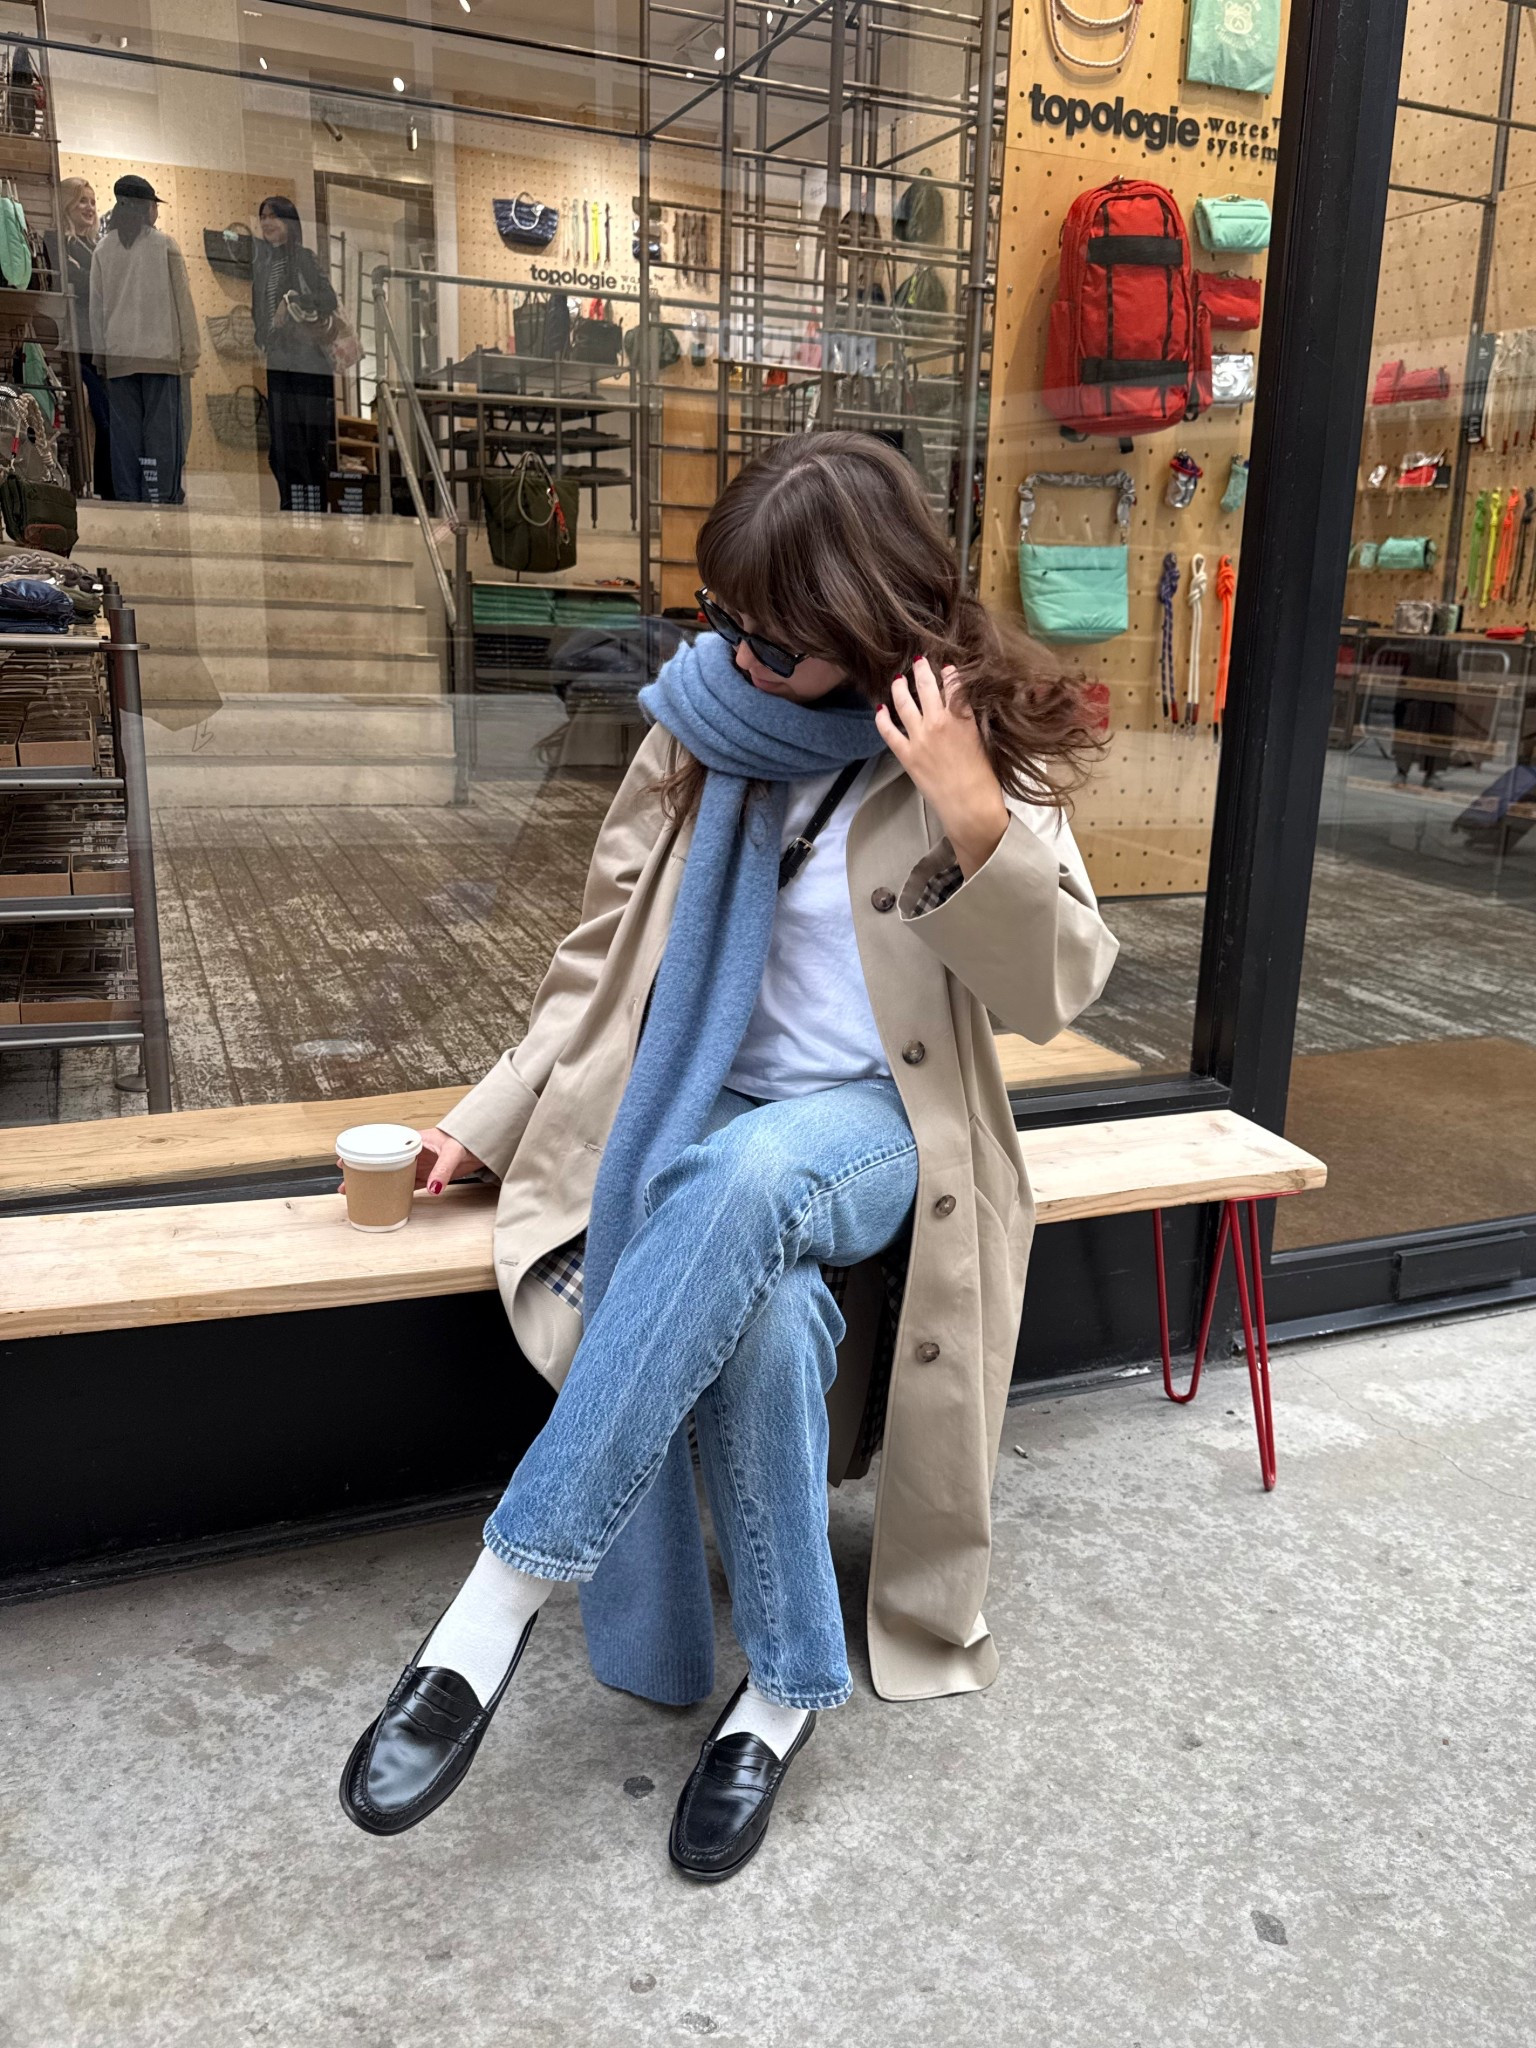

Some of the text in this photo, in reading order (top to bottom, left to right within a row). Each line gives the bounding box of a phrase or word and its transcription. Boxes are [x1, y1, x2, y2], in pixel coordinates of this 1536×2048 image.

[1029, 83, 1200, 150] topologie
[1207, 137, 1278, 161] system
[530, 264, 617, 290] topologie
